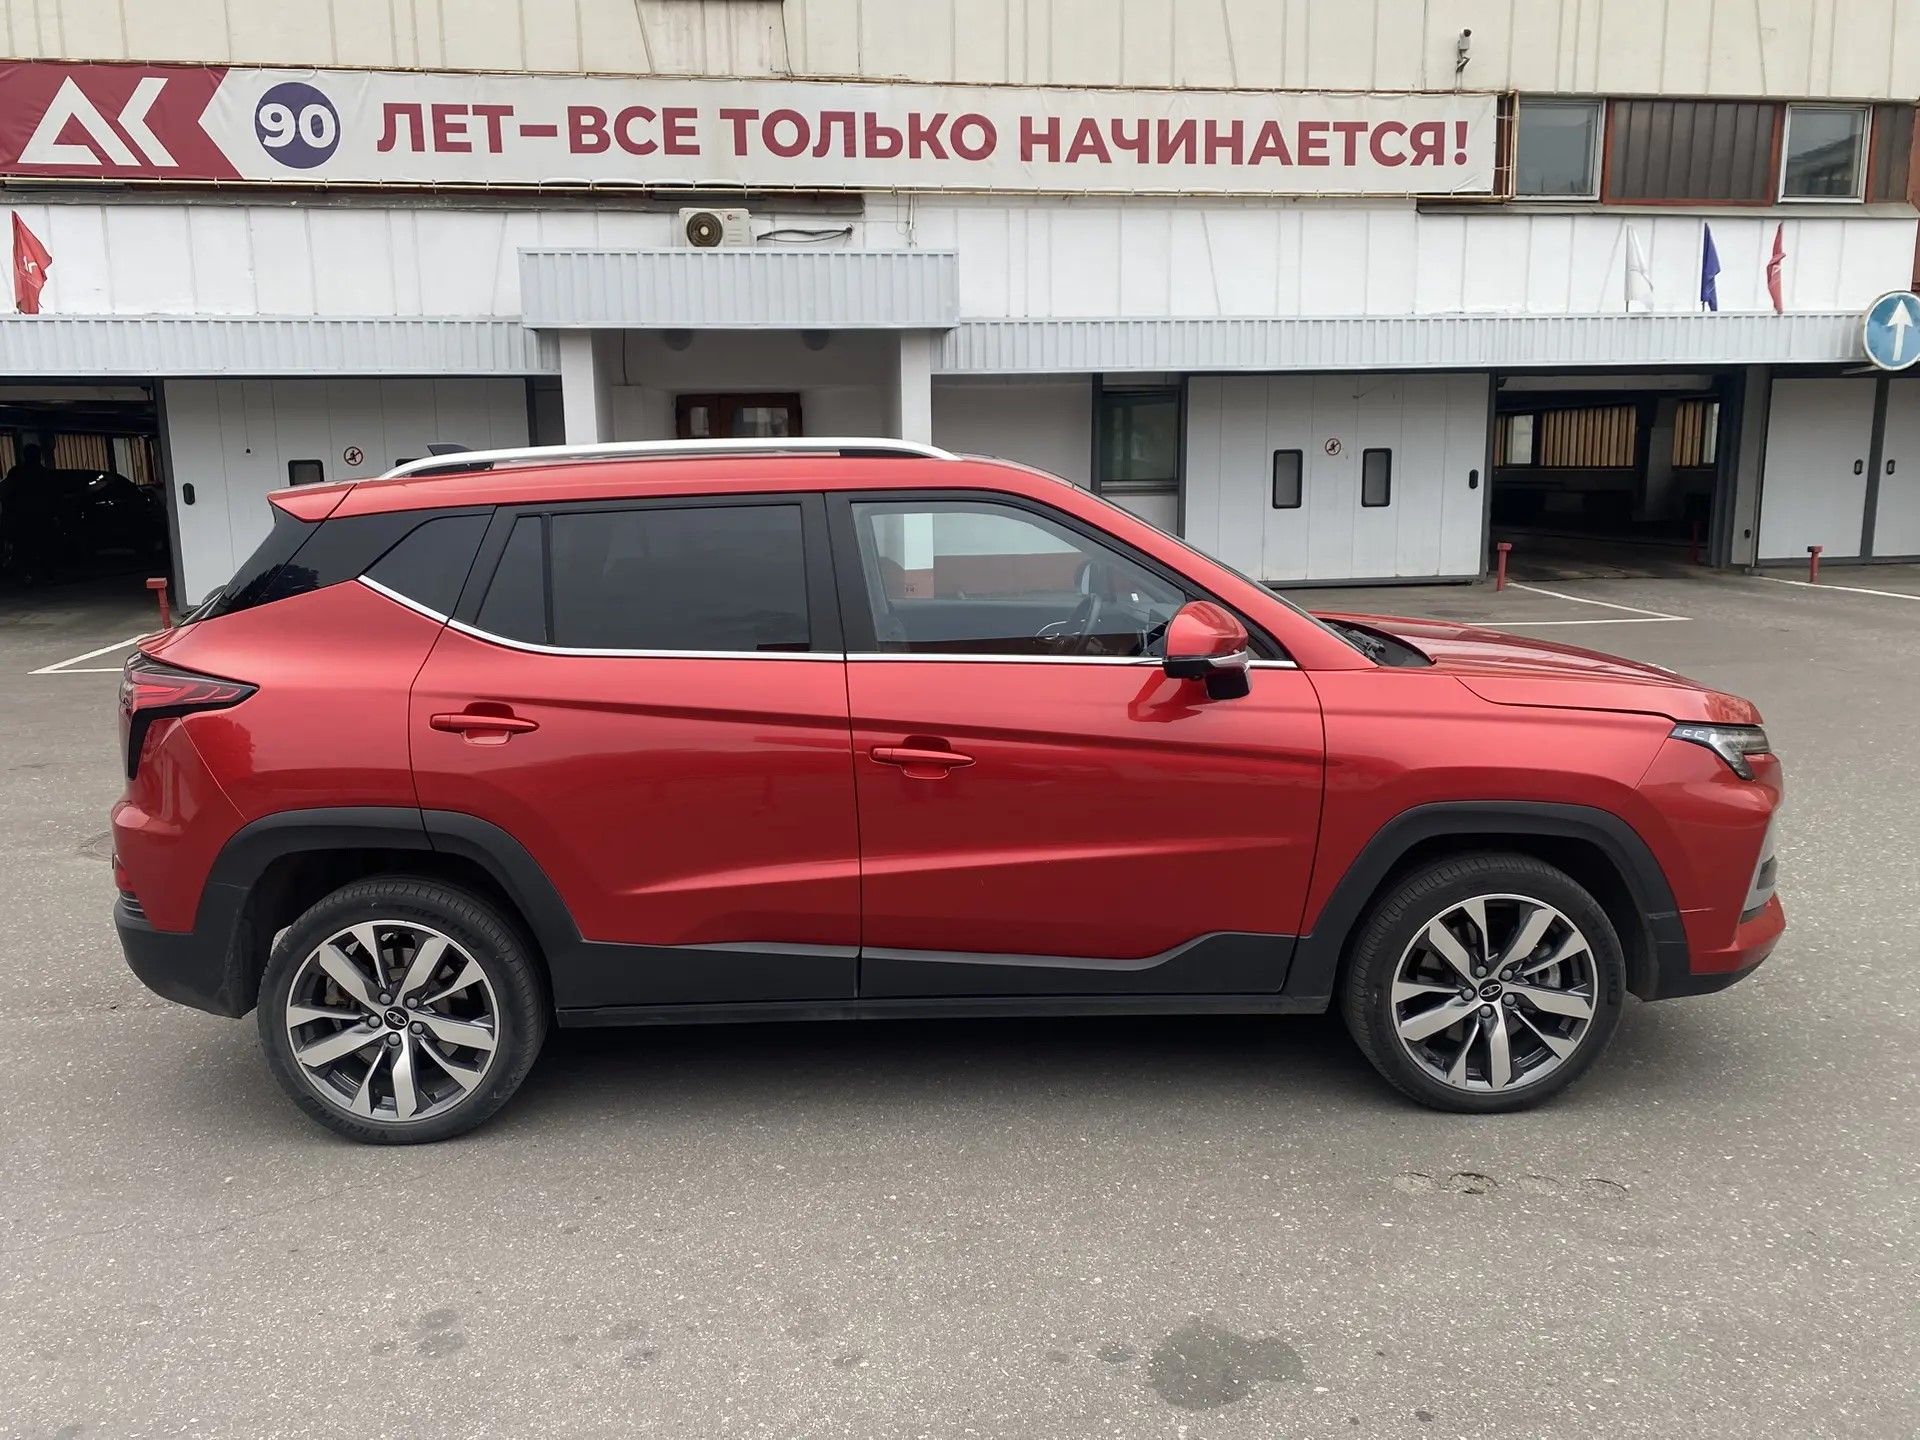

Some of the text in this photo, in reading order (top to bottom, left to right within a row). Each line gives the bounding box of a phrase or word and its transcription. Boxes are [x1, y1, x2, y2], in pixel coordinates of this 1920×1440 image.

[258, 103, 336, 149] 90
[719, 108, 998, 162] ТОЛЬКО
[1019, 116, 1468, 167] НАЧИНАЕТСЯ!
